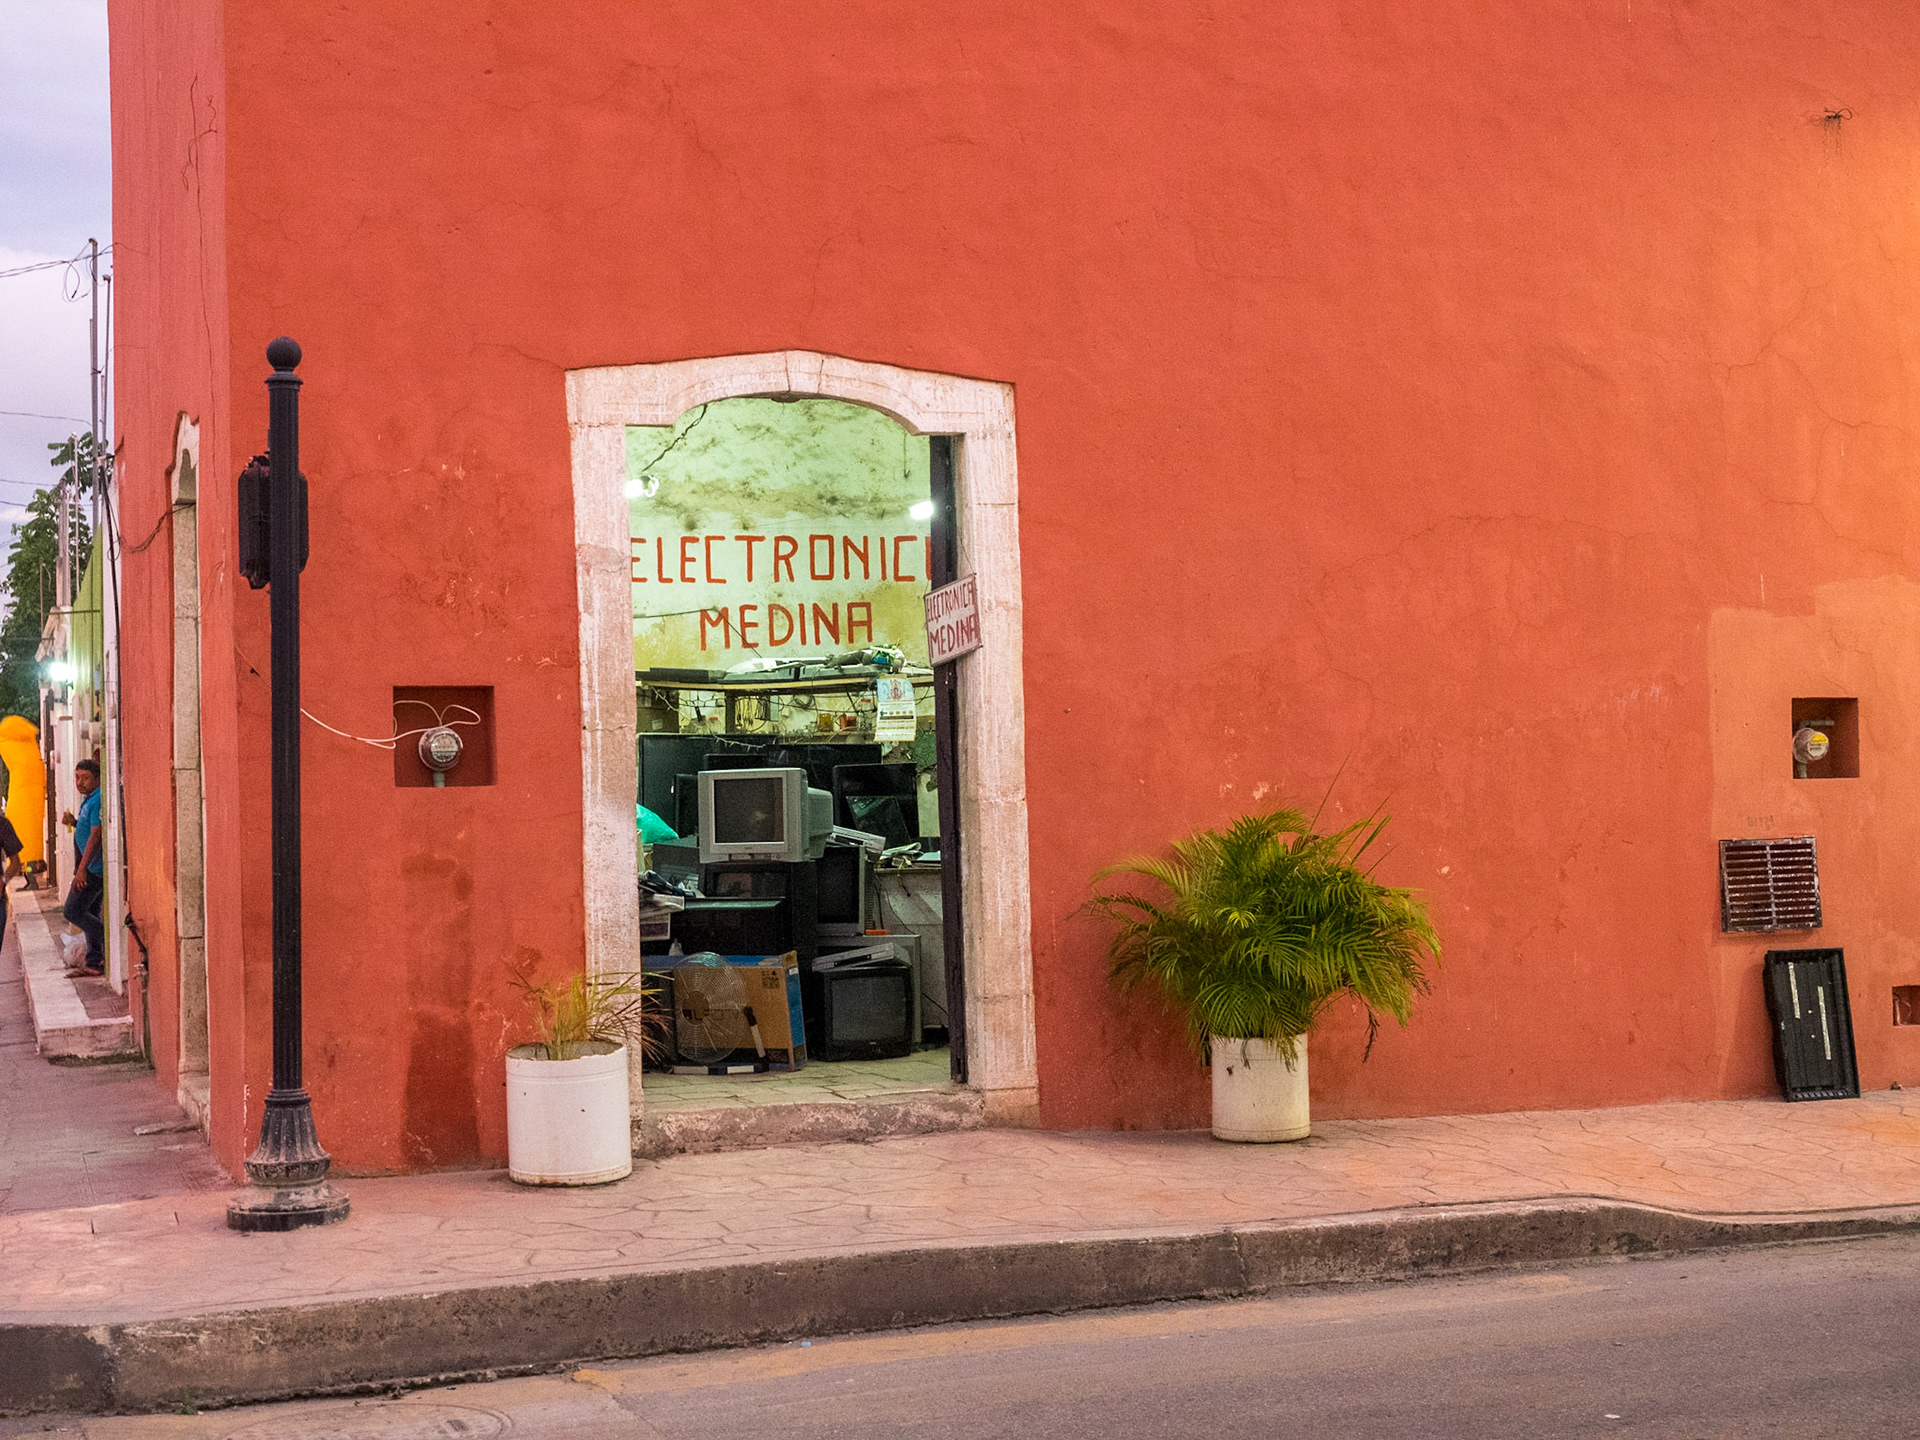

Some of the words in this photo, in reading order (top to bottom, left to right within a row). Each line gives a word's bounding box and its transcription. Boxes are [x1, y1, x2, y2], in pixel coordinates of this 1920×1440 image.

[631, 534, 932, 584] ELECTRONIC
[699, 602, 874, 652] MEDINA
[929, 612, 980, 659] MEDINA
